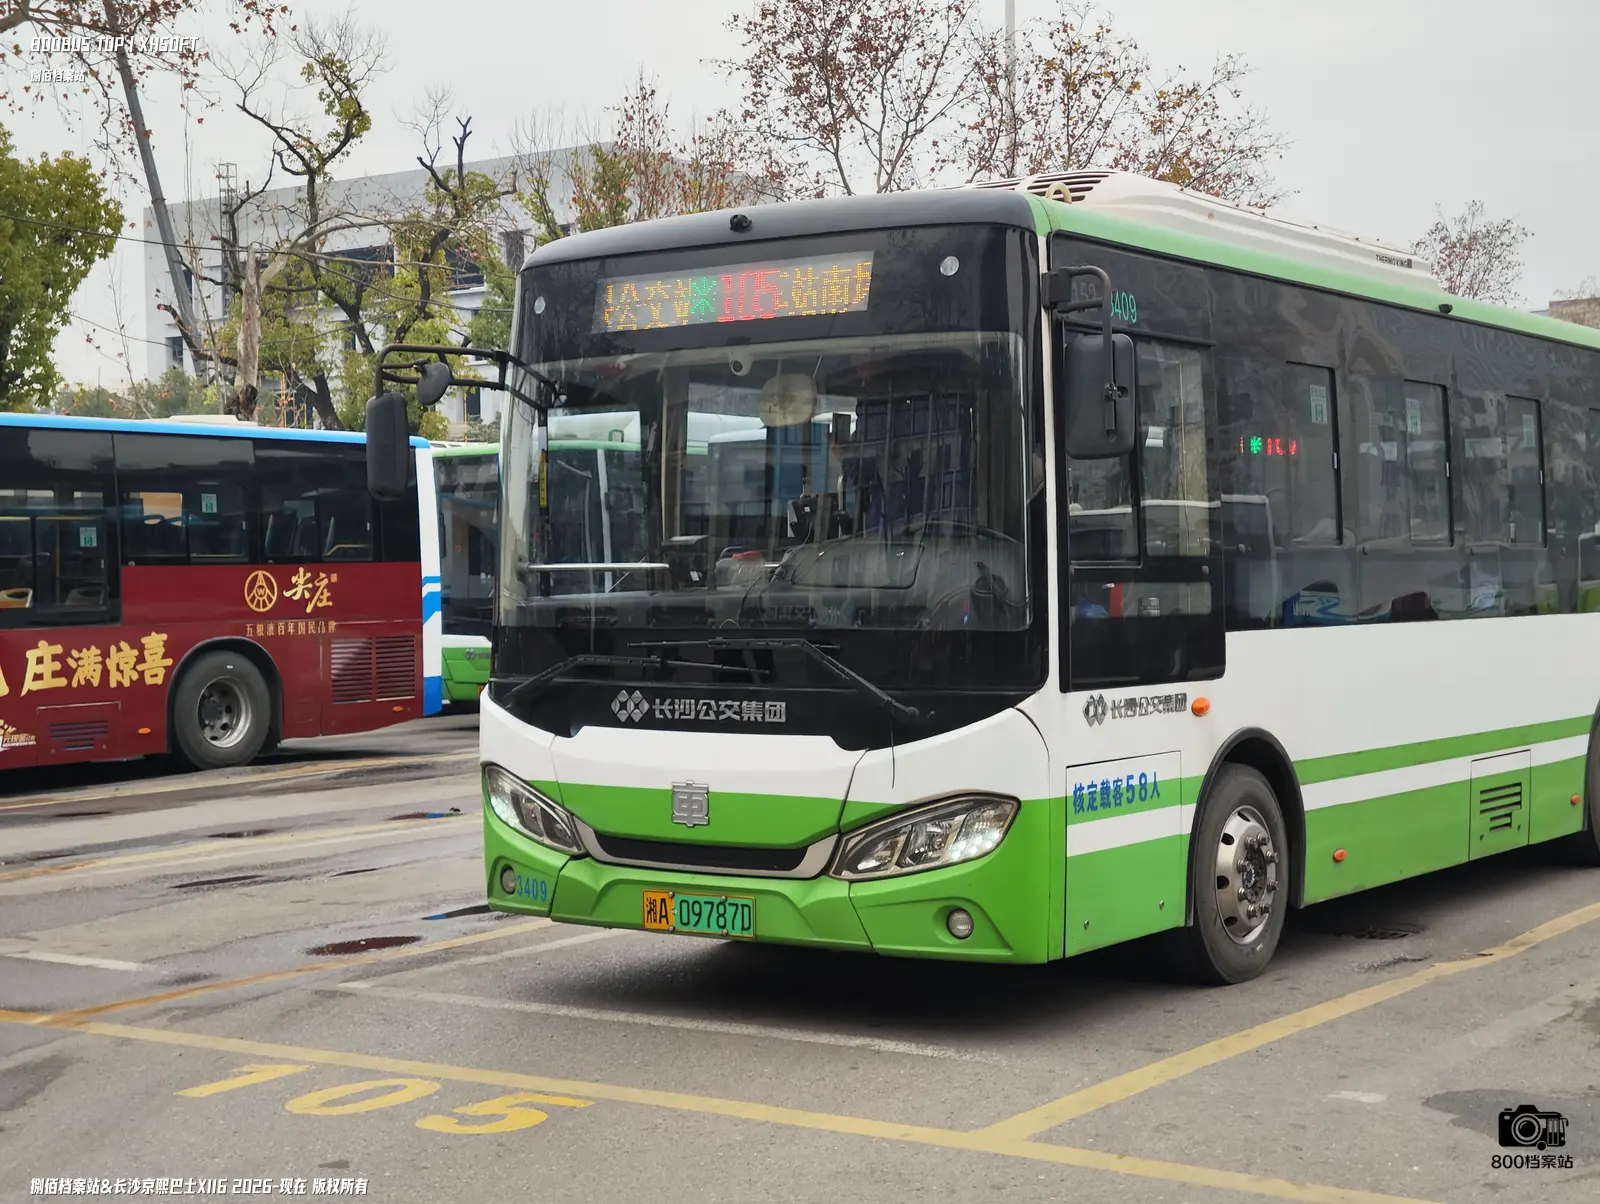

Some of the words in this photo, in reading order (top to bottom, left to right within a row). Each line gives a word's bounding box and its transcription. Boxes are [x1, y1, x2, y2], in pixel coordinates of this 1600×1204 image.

[719, 269, 785, 323] 105
[282, 566, 334, 614] 尖庄
[0, 631, 174, 698] 庄满惊喜
[652, 698, 787, 723] 长沙公交集团
[1110, 692, 1188, 720] 长沙公交集团
[1072, 771, 1161, 816] 核定载客58人
[516, 875, 548, 902] 3409
[645, 896, 670, 926] 湘A
[678, 898, 752, 932] 09787D
[173, 1063, 597, 1135] 105
